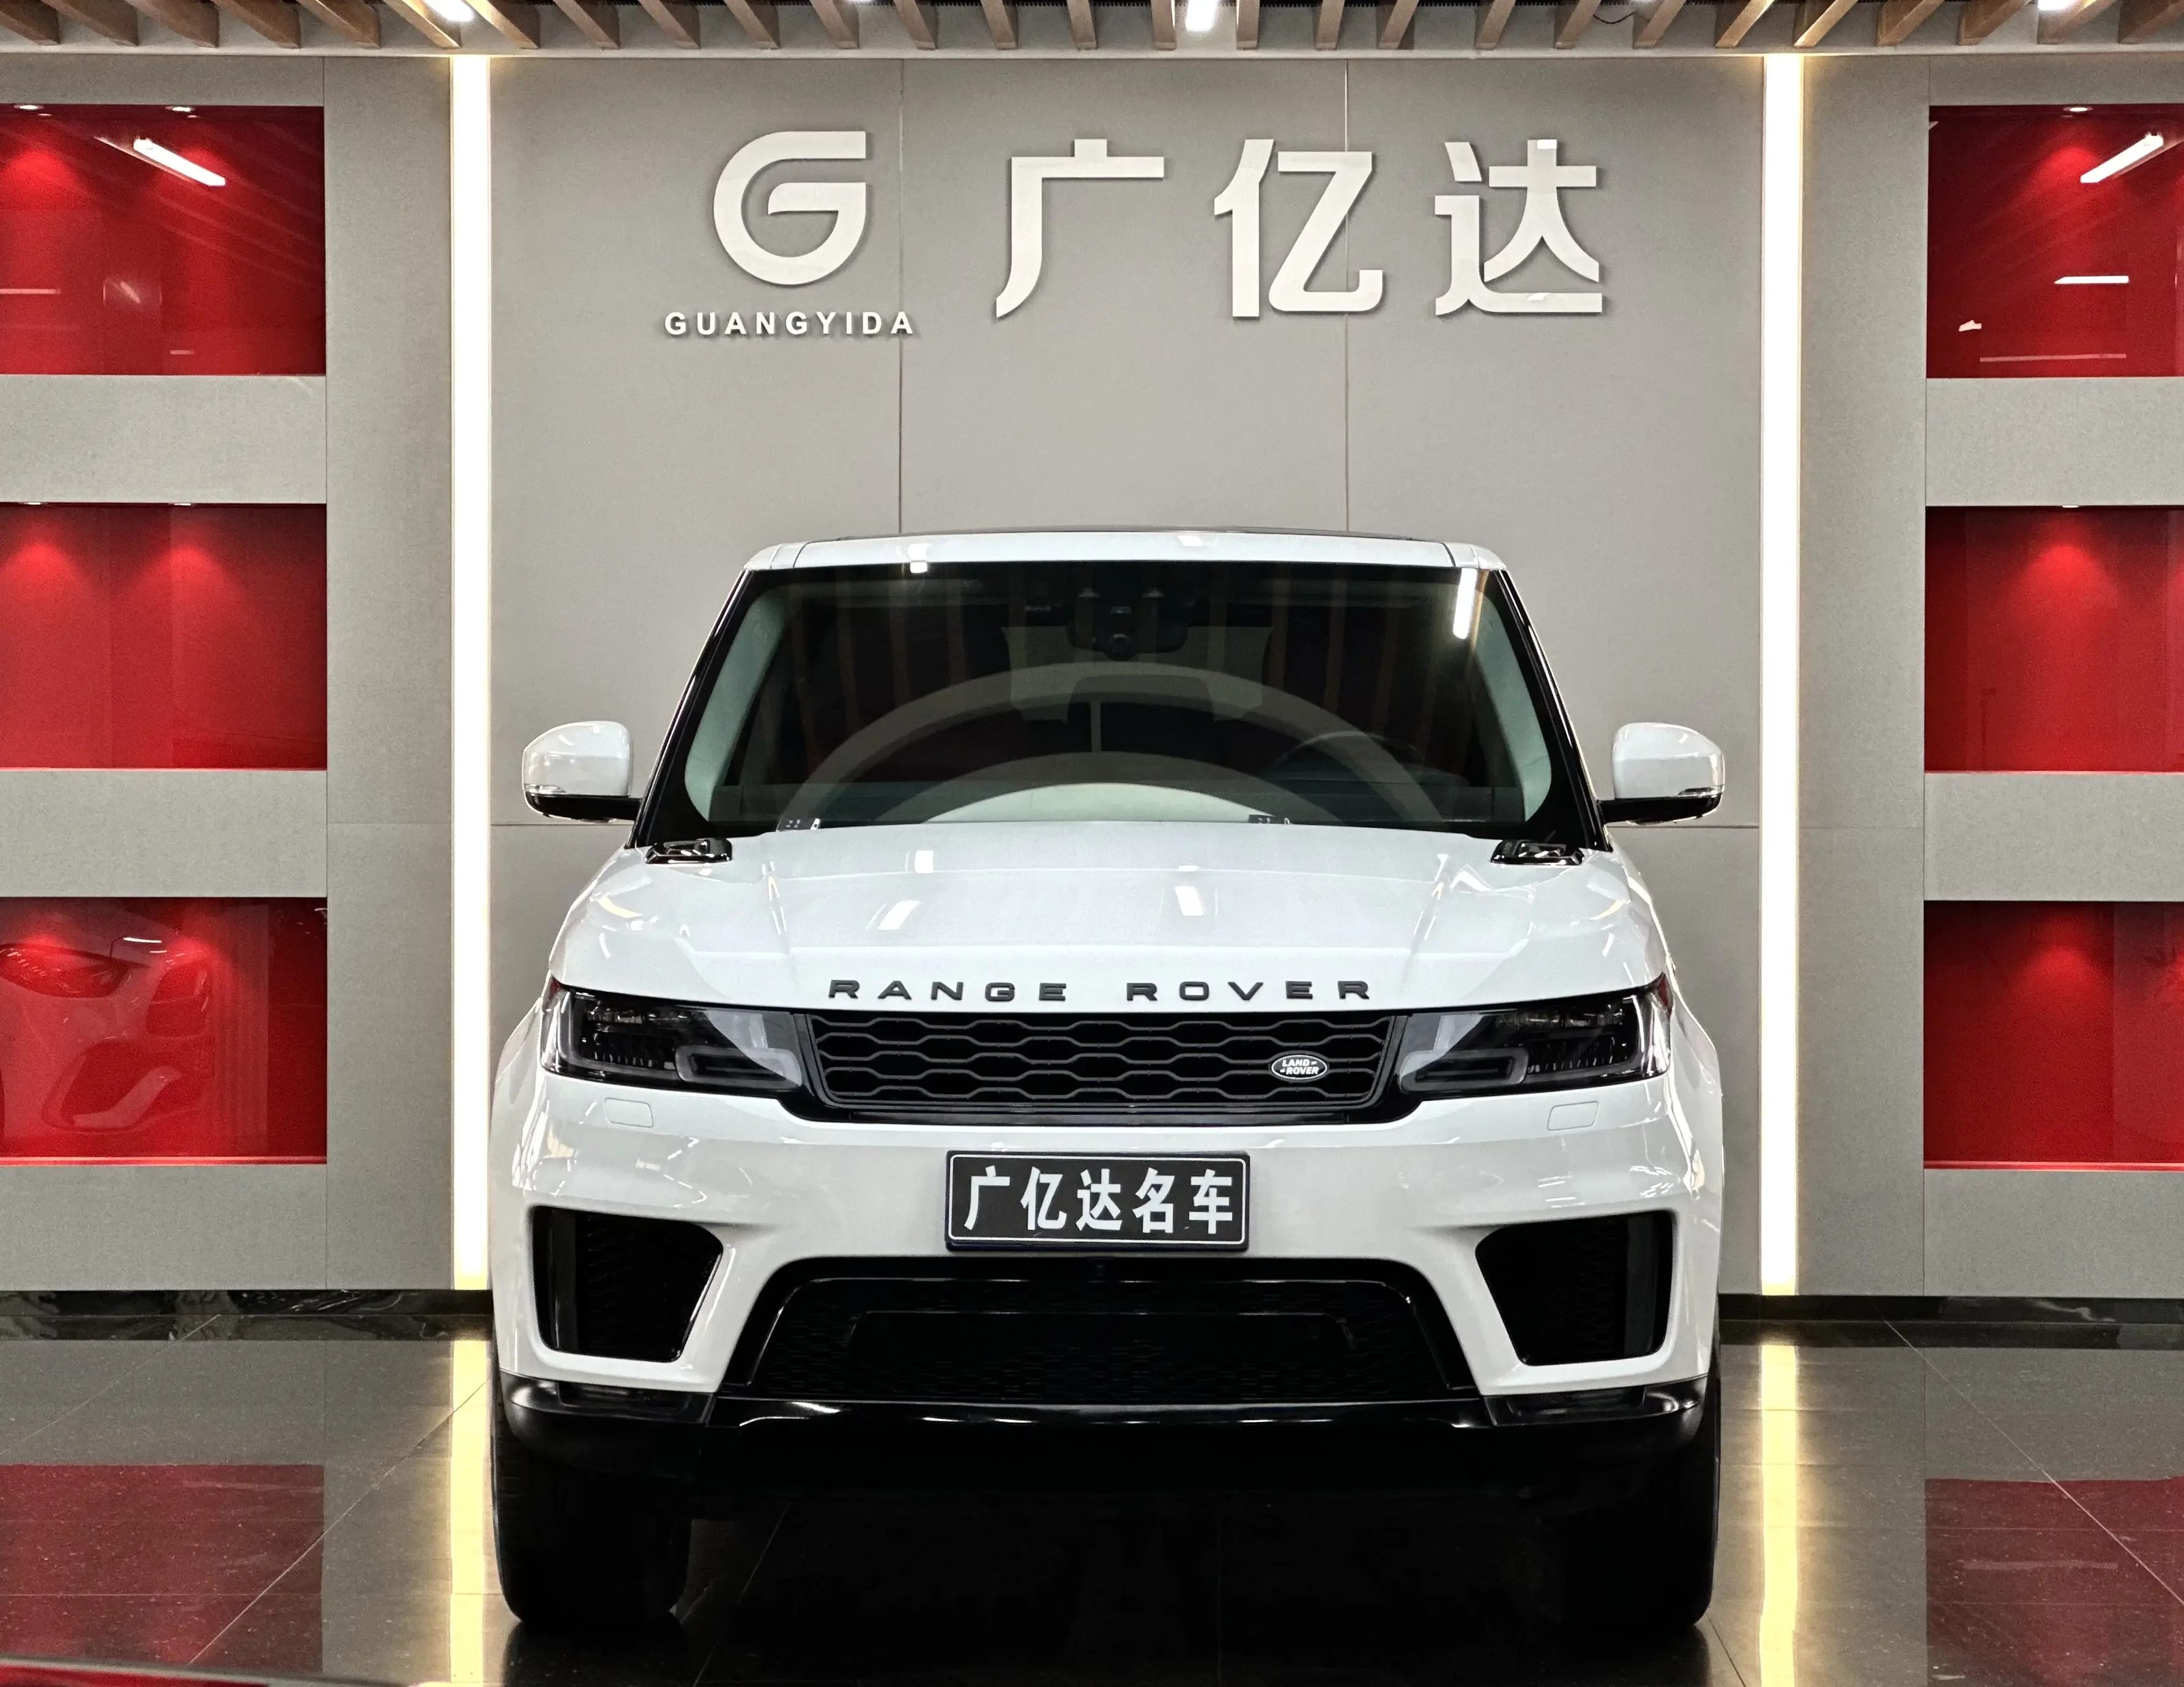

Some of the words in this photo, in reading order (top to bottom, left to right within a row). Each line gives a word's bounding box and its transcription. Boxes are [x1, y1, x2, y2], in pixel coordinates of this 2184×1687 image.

[996, 139, 1602, 318] 广亿达
[664, 311, 913, 335] GUANGYIDA
[828, 979, 1066, 1002] RANGE
[1126, 981, 1370, 1002] ROVER
[1282, 1059, 1309, 1067] LAND
[1285, 1067, 1320, 1075] ROVER
[964, 1165, 1233, 1234] 广亿达名车
